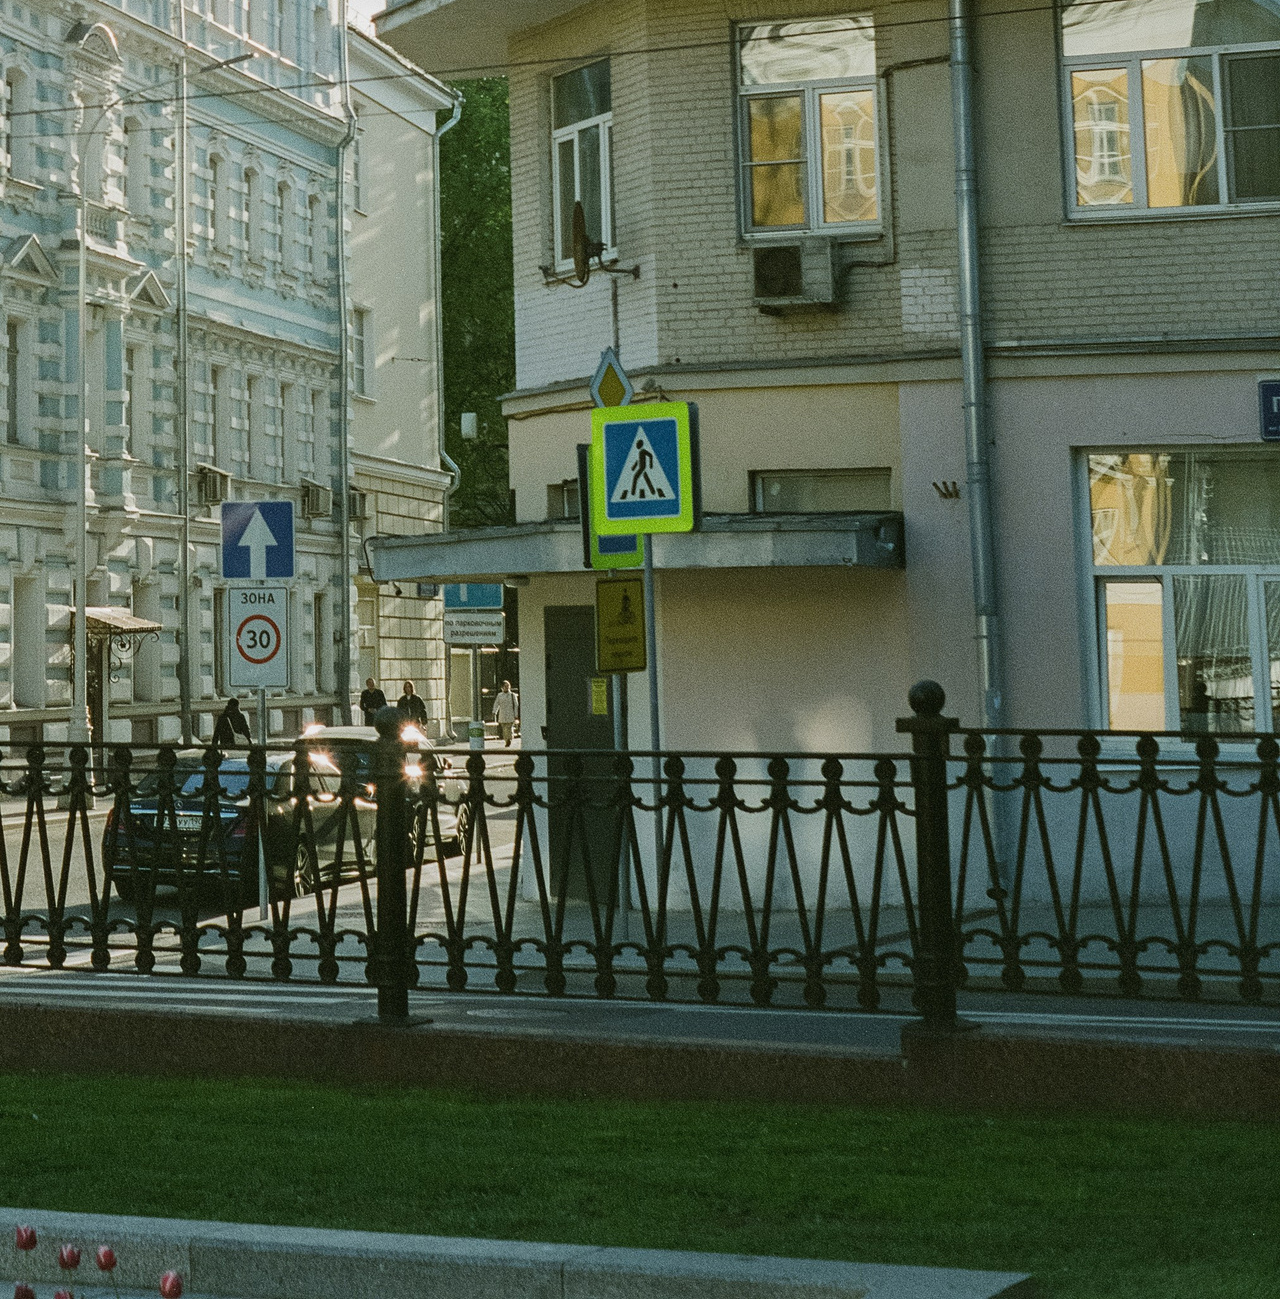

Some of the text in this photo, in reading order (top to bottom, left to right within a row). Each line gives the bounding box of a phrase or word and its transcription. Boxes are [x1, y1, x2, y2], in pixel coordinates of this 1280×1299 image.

[240, 592, 276, 604] ЗОНА
[455, 620, 502, 628] парковочным
[246, 629, 271, 649] 30
[450, 630, 497, 638] разрешениям
